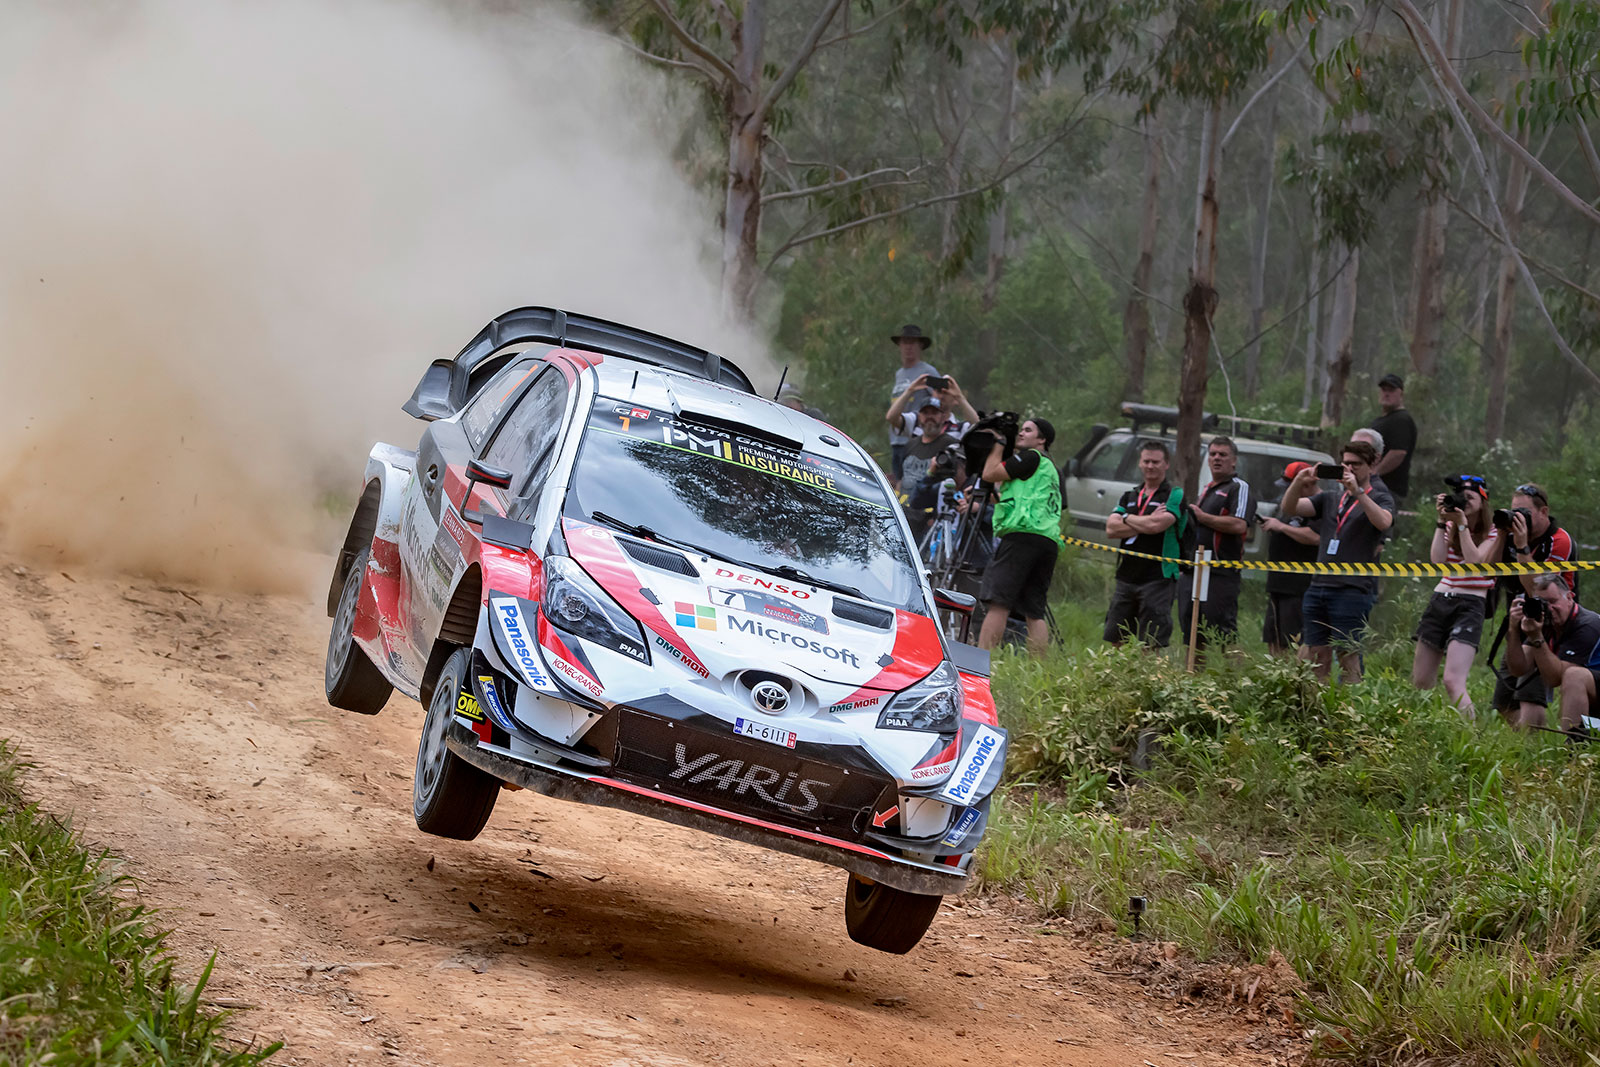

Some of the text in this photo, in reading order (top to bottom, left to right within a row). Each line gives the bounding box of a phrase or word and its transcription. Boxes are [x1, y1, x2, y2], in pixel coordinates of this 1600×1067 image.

[614, 405, 650, 419] GR
[655, 415, 867, 482] TOYOTA GAZOO Racing
[662, 426, 733, 460] PMI
[738, 445, 835, 479] PREMIUM MOTORSPORT
[739, 452, 837, 490] INSURANCE
[715, 568, 811, 599] DENSO
[718, 589, 737, 606] 7
[498, 604, 547, 687] Panasonic
[618, 642, 645, 660] PIAA
[655, 636, 710, 680] DMG MORI
[727, 614, 861, 669] Microsoft
[552, 658, 604, 697] KONECRANES
[829, 697, 879, 713] DMG MORI
[746, 724, 785, 742] A-6111
[886, 718, 908, 727] PIAA
[911, 764, 951, 780] KONECRANES
[948, 735, 996, 800] Panasonic
